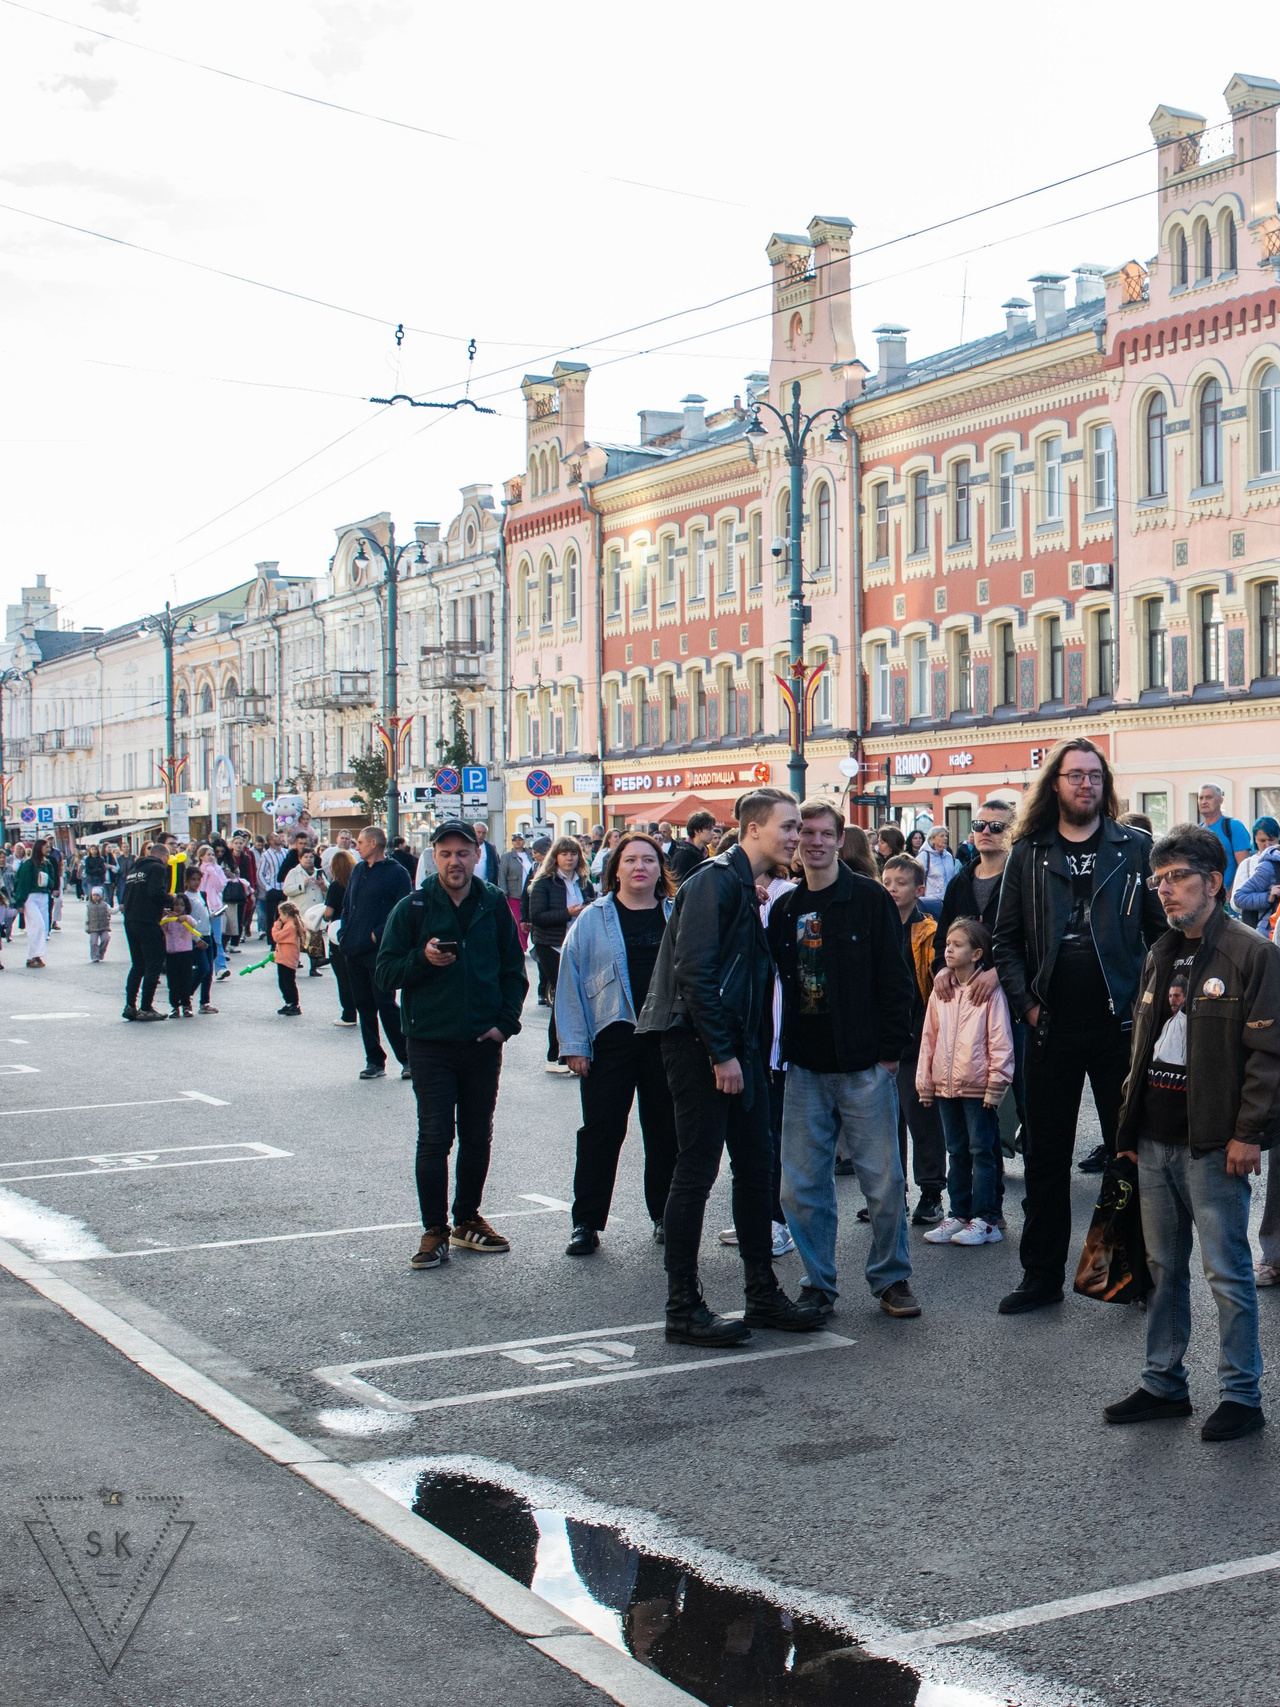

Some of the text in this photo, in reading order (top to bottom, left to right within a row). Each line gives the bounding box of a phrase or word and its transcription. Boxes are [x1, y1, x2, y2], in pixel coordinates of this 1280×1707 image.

[894, 752, 931, 776] RAMO
[949, 751, 974, 769] кафе
[614, 774, 653, 792] РЕБРО
[656, 774, 682, 788] БАР
